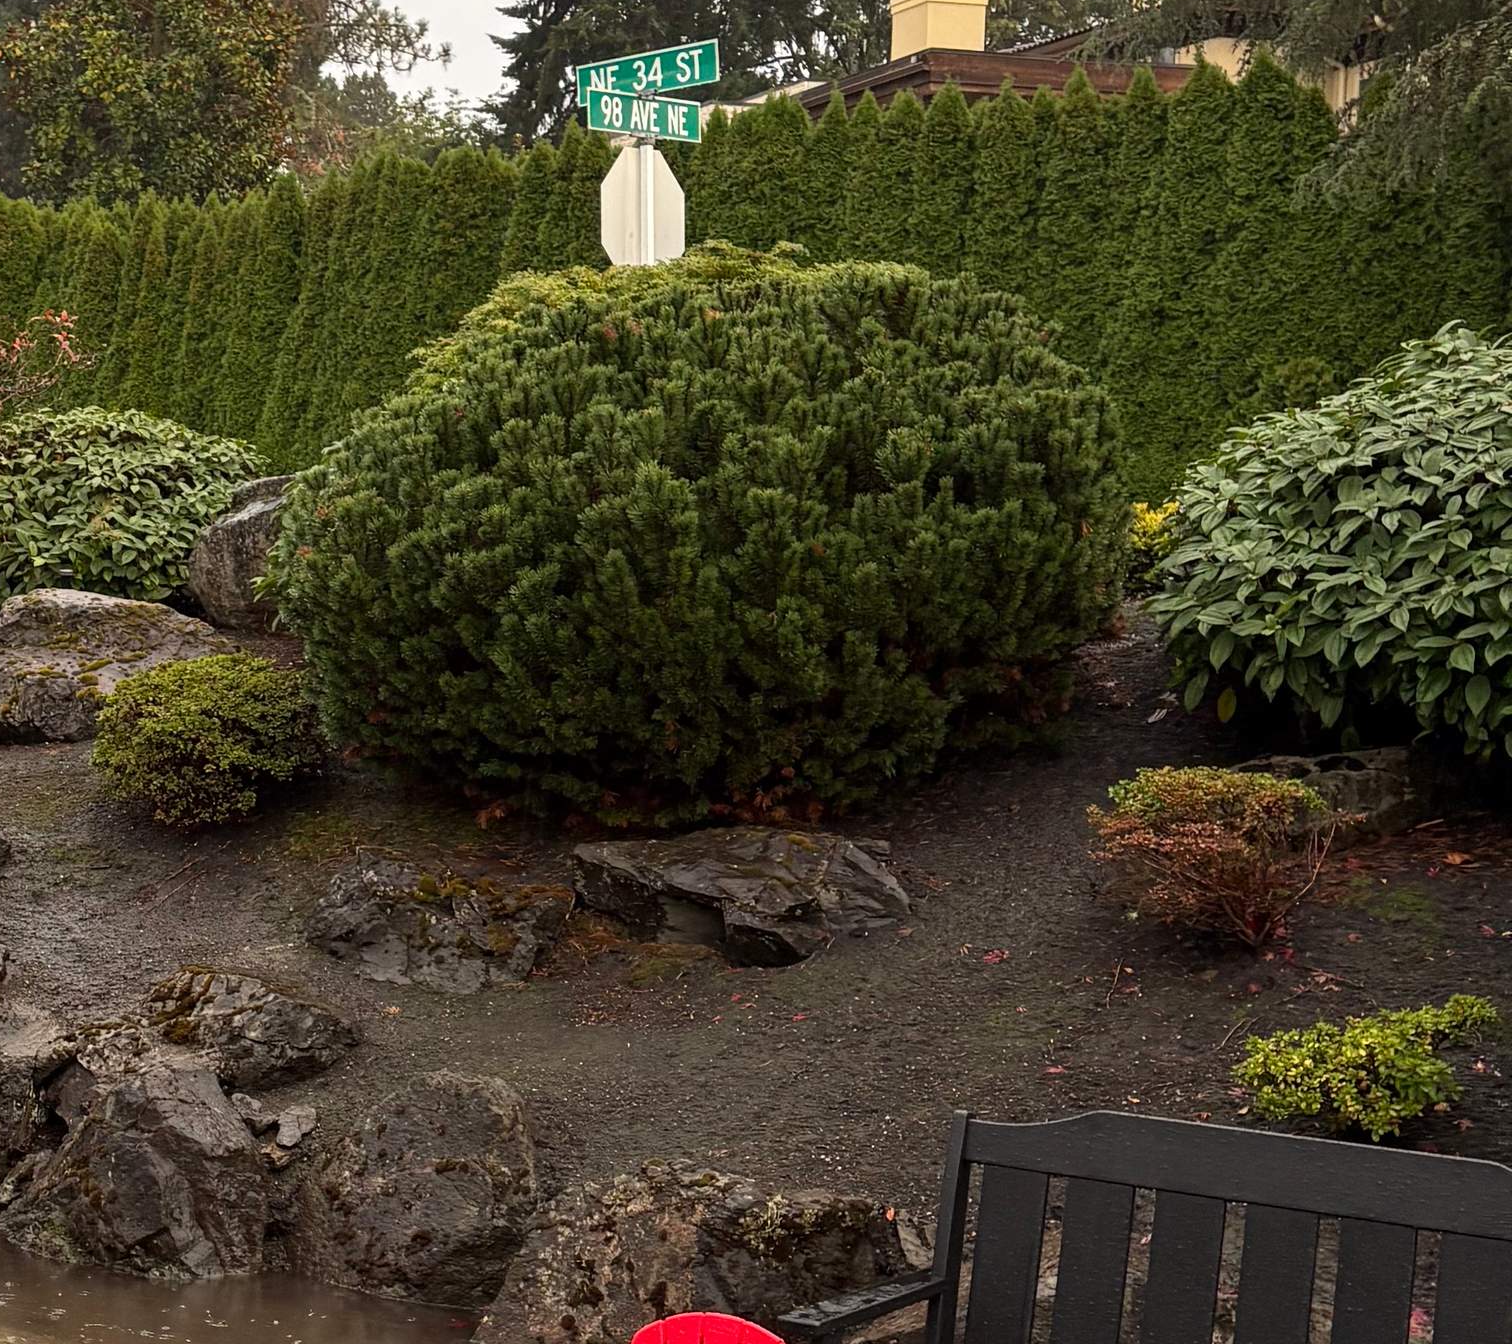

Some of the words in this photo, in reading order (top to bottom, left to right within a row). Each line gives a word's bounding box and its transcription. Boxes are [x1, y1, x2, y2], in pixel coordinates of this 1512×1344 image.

[590, 65, 619, 92] NE
[632, 56, 663, 91] 34
[676, 49, 703, 83] ST
[601, 95, 623, 128] 98
[630, 99, 660, 132] AVE
[668, 103, 689, 136] NE
